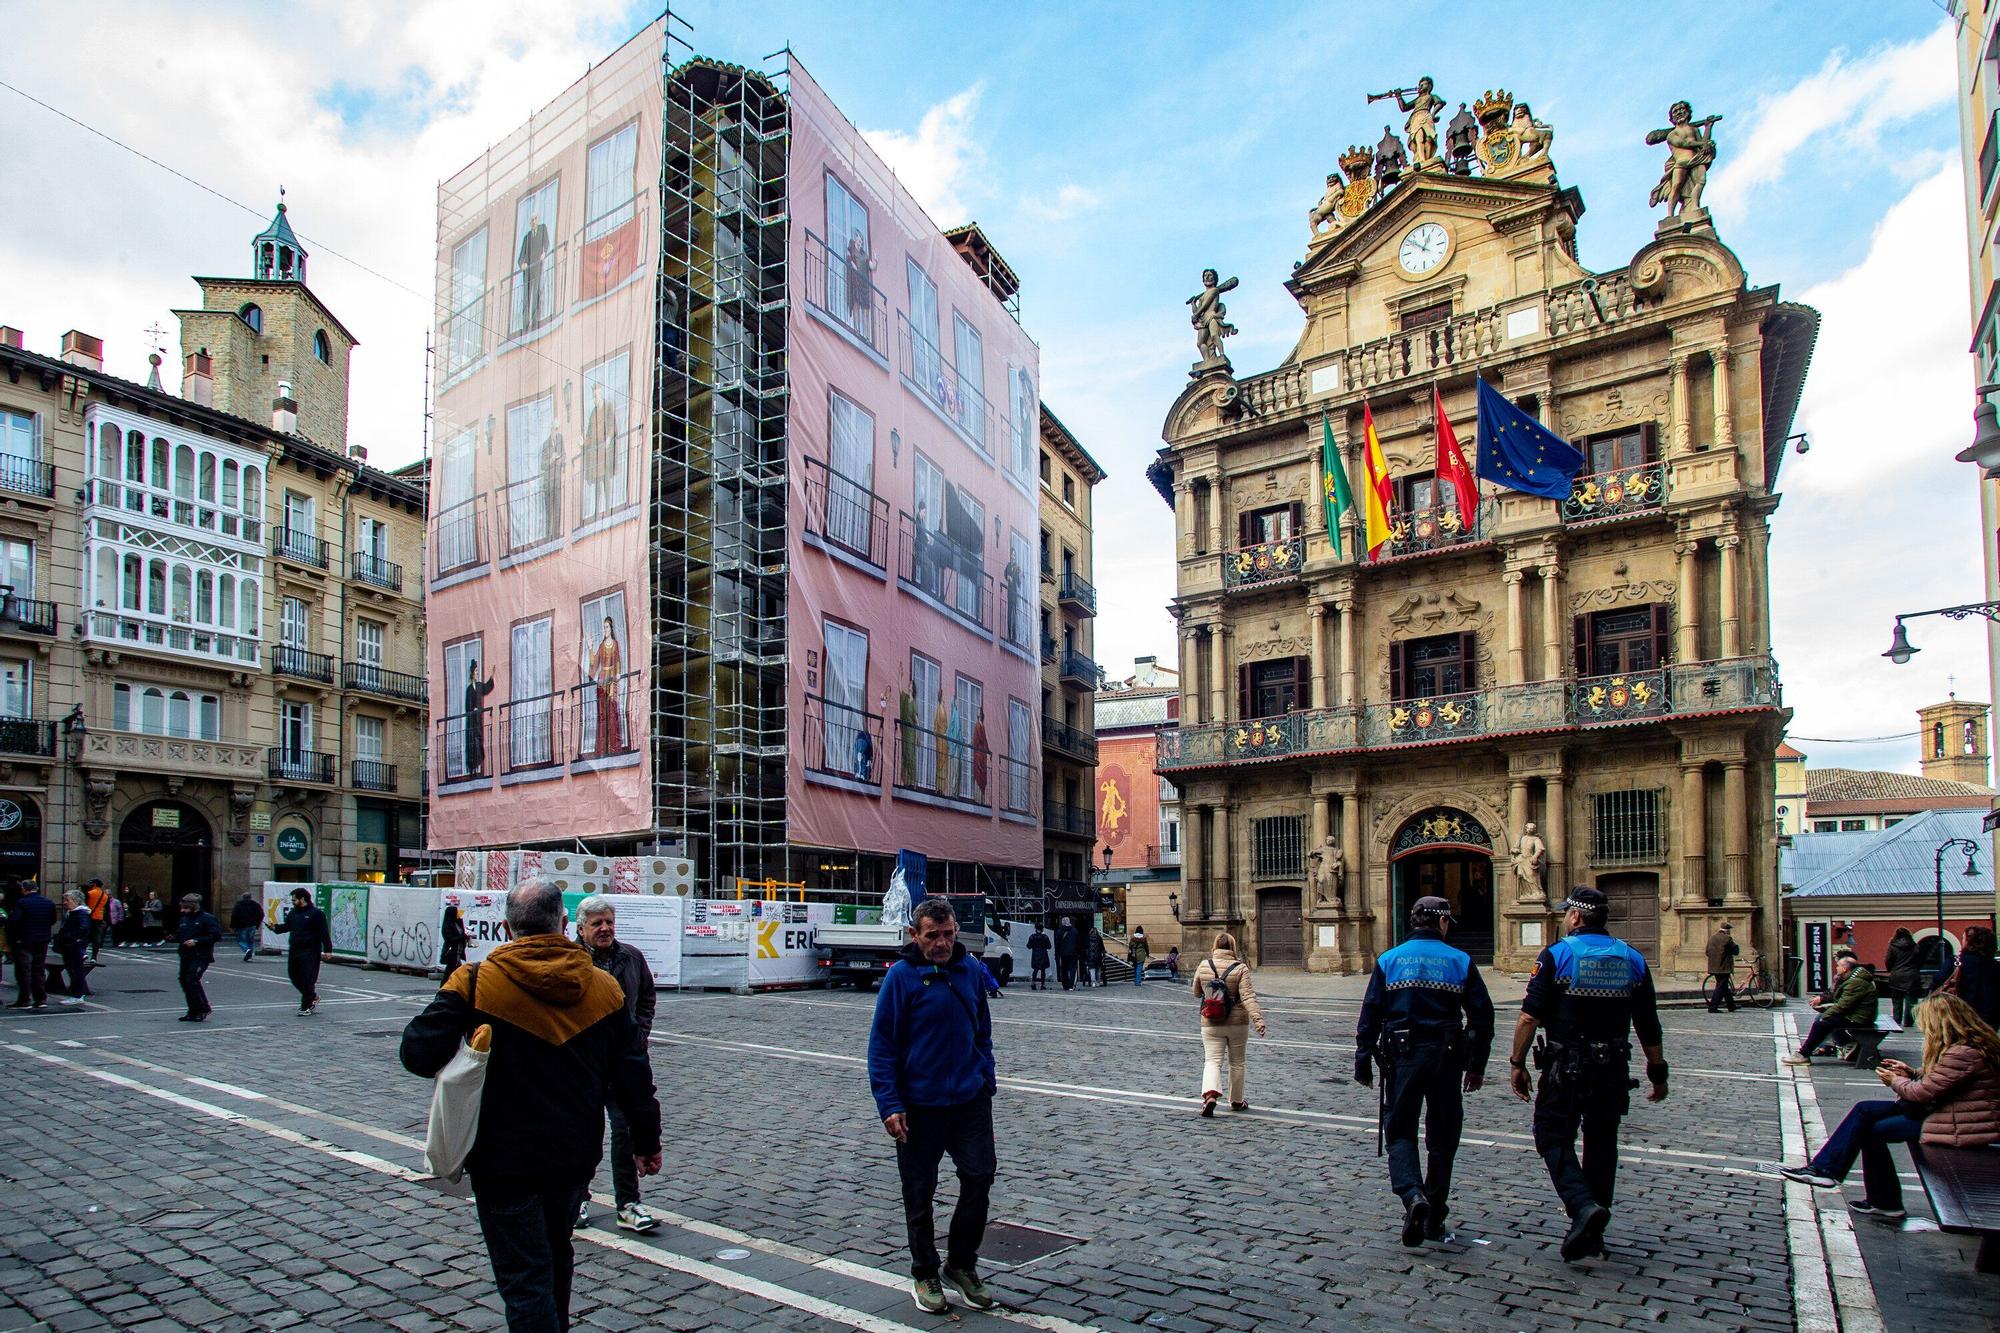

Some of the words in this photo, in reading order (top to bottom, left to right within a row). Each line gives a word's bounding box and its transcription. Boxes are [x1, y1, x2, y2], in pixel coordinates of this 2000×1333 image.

[279, 841, 306, 849] INFANTIL
[1812, 926, 1821, 989] ZENTRAL
[1579, 969, 1629, 978] MUNICIPAL
